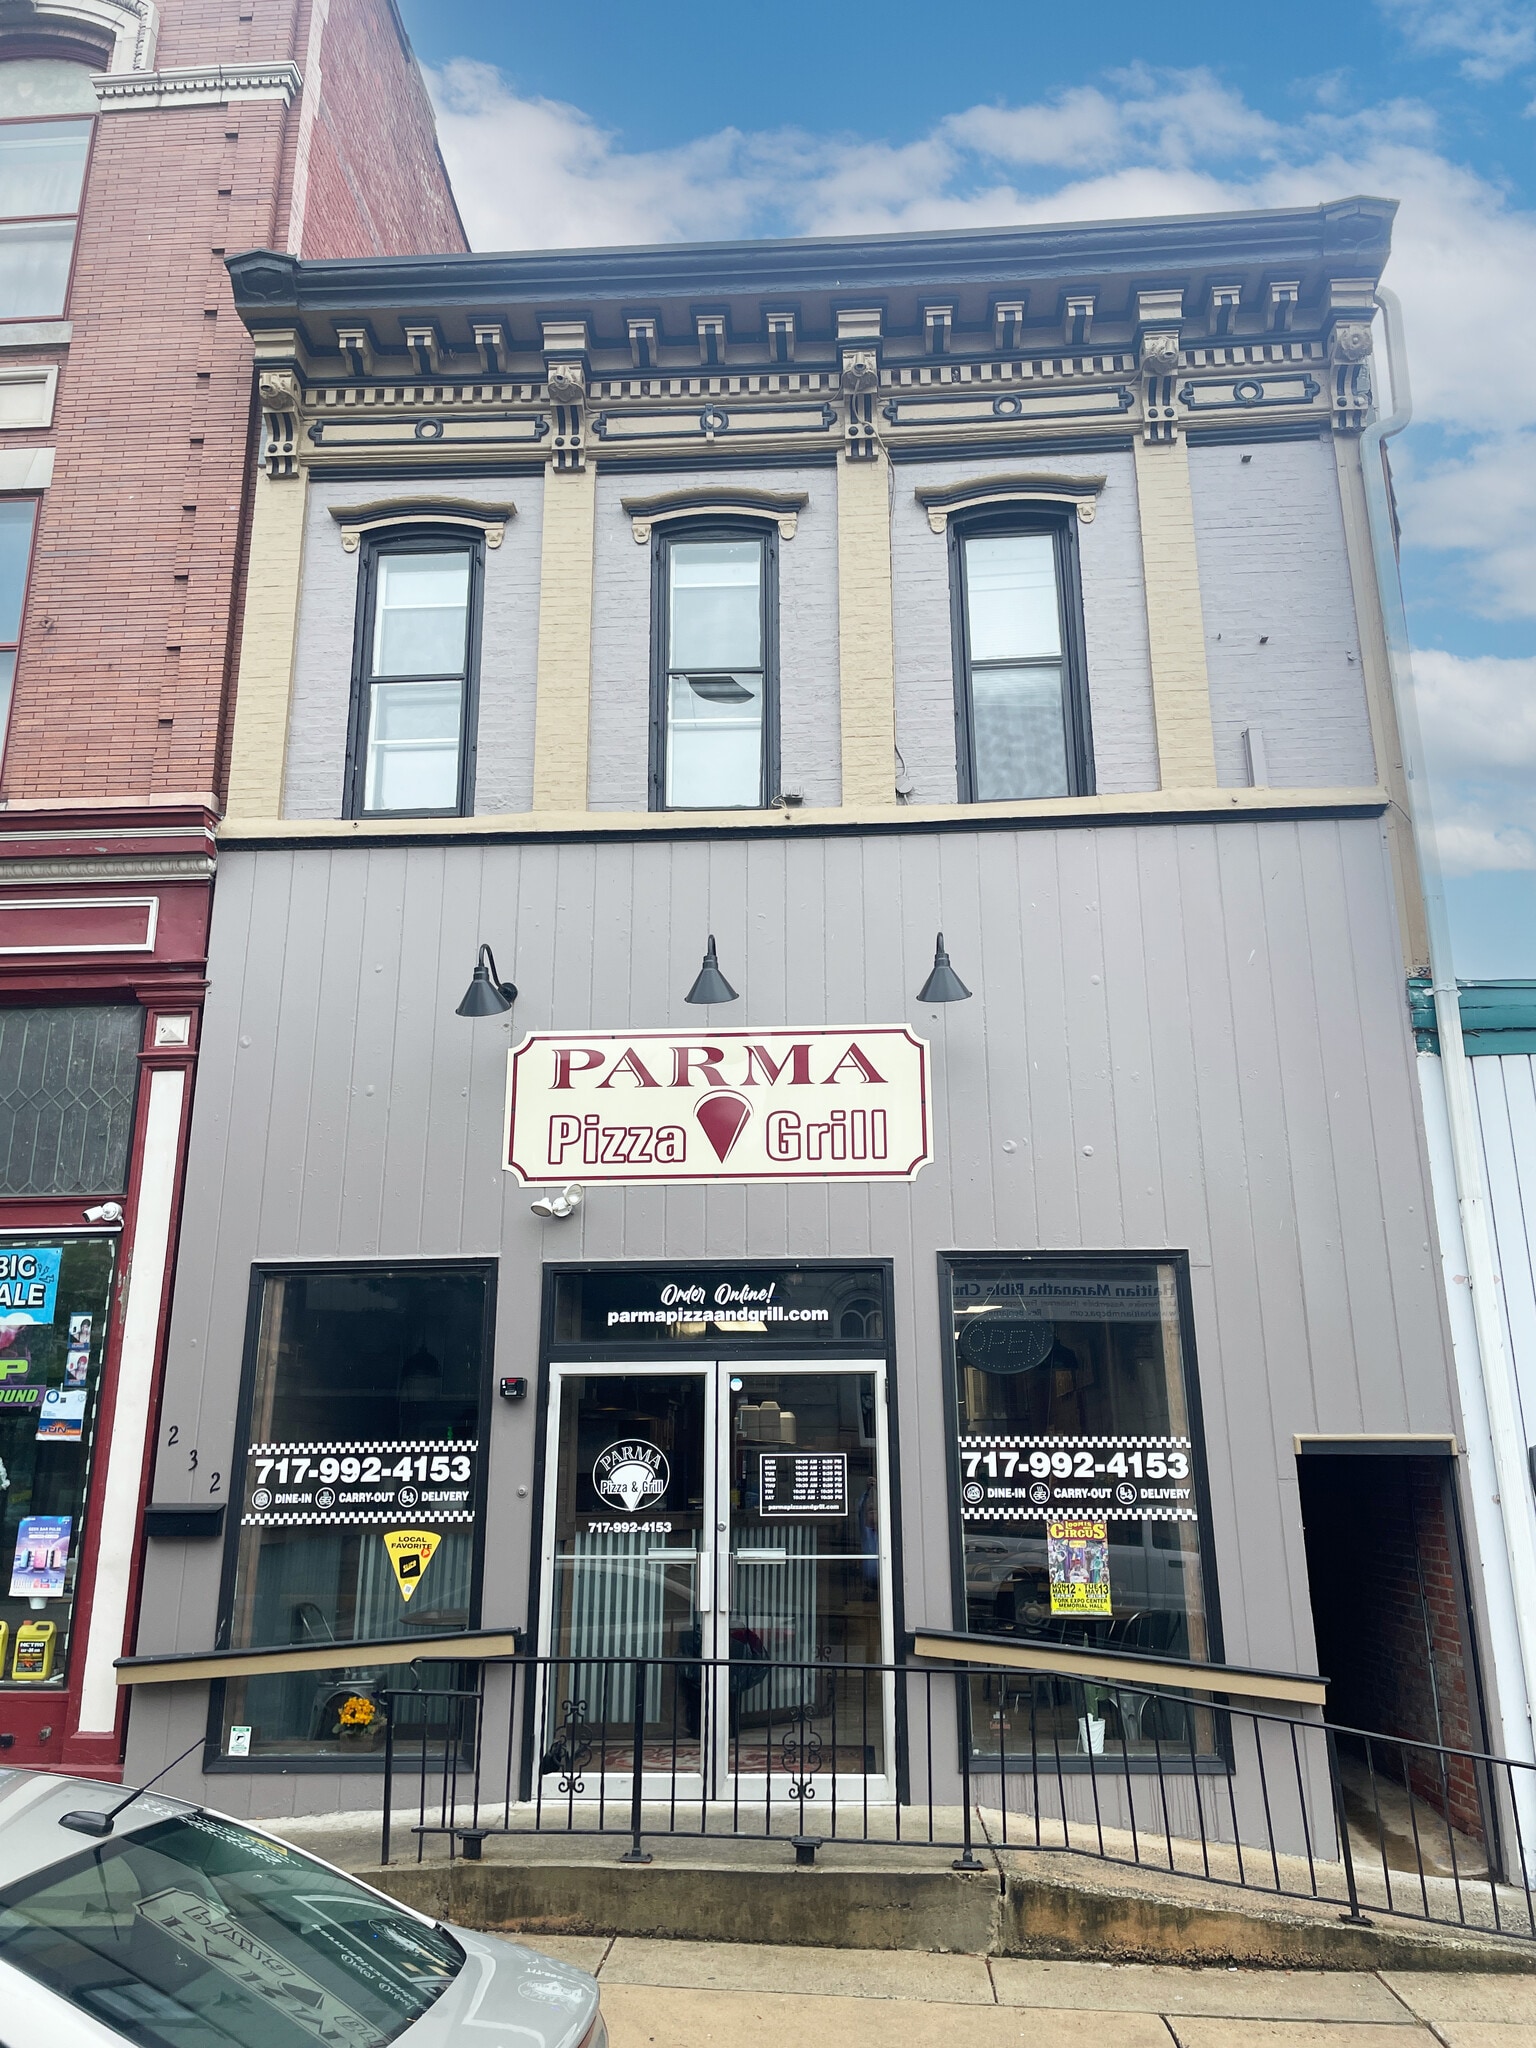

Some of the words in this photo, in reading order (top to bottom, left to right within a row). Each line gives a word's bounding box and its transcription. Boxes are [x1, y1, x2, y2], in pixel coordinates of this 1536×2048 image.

[548, 1041, 889, 1090] PARMA
[548, 1113, 687, 1165] Pizza
[766, 1109, 888, 1160] Grill
[0, 1282, 46, 1308] ALE
[660, 1283, 707, 1305] Order
[714, 1281, 776, 1305] Online!
[607, 1306, 829, 1326] parmapizzaandgrill.com
[967, 1327, 1046, 1356] OPEN
[254, 1455, 471, 1484] 717-992-4153
[599, 1445, 662, 1472] PARMA
[961, 1450, 1189, 1479] 717-992-4153
[275, 1492, 313, 1504] DINE-IN
[339, 1491, 396, 1503] CARRY-OUT
[421, 1490, 469, 1502] DELIVERY
[601, 1480, 628, 1493] Pizza
[631, 1481, 638, 1492] &
[642, 1480, 664, 1493] Grill
[987, 1488, 1026, 1499] DINE-IN
[1053, 1488, 1112, 1499] CARRY-OUT
[1140, 1488, 1191, 1499] DELIVERY
[587, 1522, 672, 1533] 717-992-4153
[1050, 1523, 1105, 1539] CIRCUS
[1066, 1584, 1076, 1594] 12
[1099, 1584, 1109, 1594] 13
